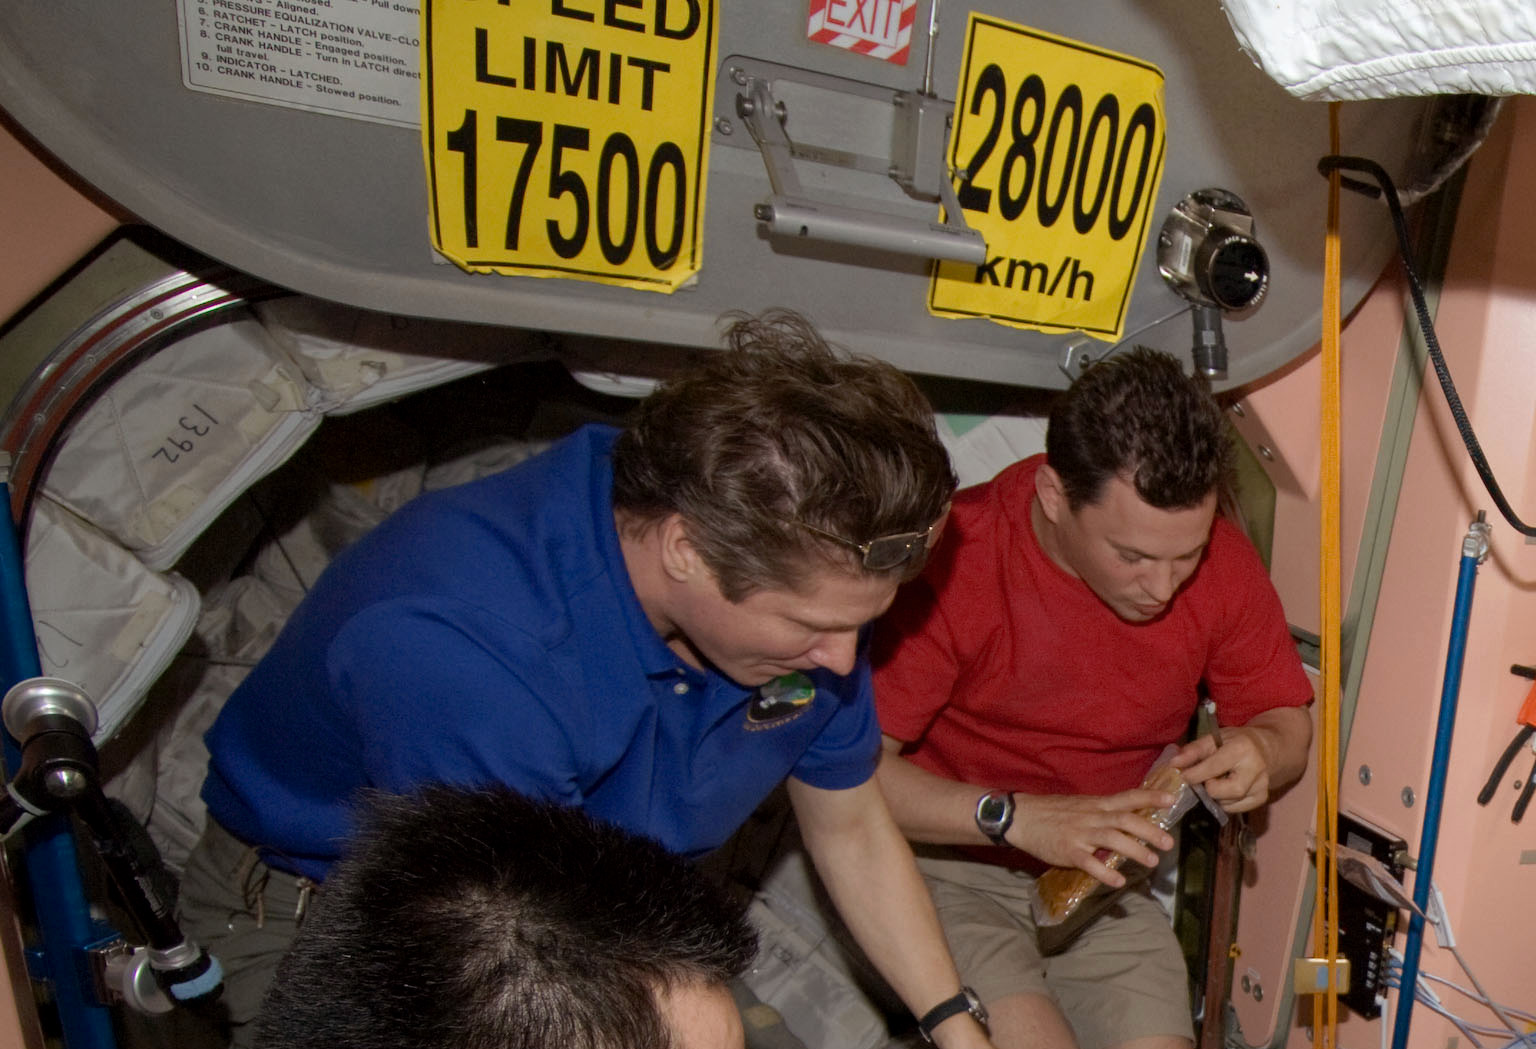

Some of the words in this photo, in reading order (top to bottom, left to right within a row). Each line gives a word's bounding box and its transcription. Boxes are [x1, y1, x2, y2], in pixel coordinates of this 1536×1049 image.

[198, 6, 208, 16] 6.
[213, 10, 266, 28] RATCHET
[280, 23, 317, 38] LATCH
[321, 32, 364, 48] position.
[213, 0, 271, 17] PRESSURE
[275, 11, 354, 34] EQUALIZATION
[357, 28, 421, 47] VALVE-CLO
[276, 0, 319, 15] Aligned.
[393, 3, 421, 16] down
[824, 0, 899, 40] EXIT
[200, 18, 210, 27] 7.
[214, 21, 253, 36] CRANK
[258, 30, 302, 46] HANDLE
[315, 41, 360, 58] Engaged
[363, 51, 407, 66] position.
[200, 29, 210, 39] 8.
[215, 32, 254, 48] CRANK
[258, 41, 302, 57] HANDLE
[315, 52, 339, 64] Turn
[342, 57, 351, 66] in
[354, 59, 389, 74] LATCH
[393, 65, 421, 80] direct
[216, 44, 232, 54] full
[236, 47, 269, 61] travel.
[196, 62, 213, 73] 10.
[217, 66, 255, 81] CRANK
[260, 74, 303, 90] HANDLE
[316, 84, 355, 99] Stowed
[358, 92, 402, 107] position.
[201, 51, 212, 61] 9.
[216, 54, 276, 74] INDICATOR
[290, 68, 343, 86] LATCHED.
[475, 28, 671, 112] LIMIT
[958, 63, 1156, 241] 28000
[447, 109, 687, 270] 17500
[976, 256, 1095, 301] km/h
[151, 403, 219, 463] 1392
